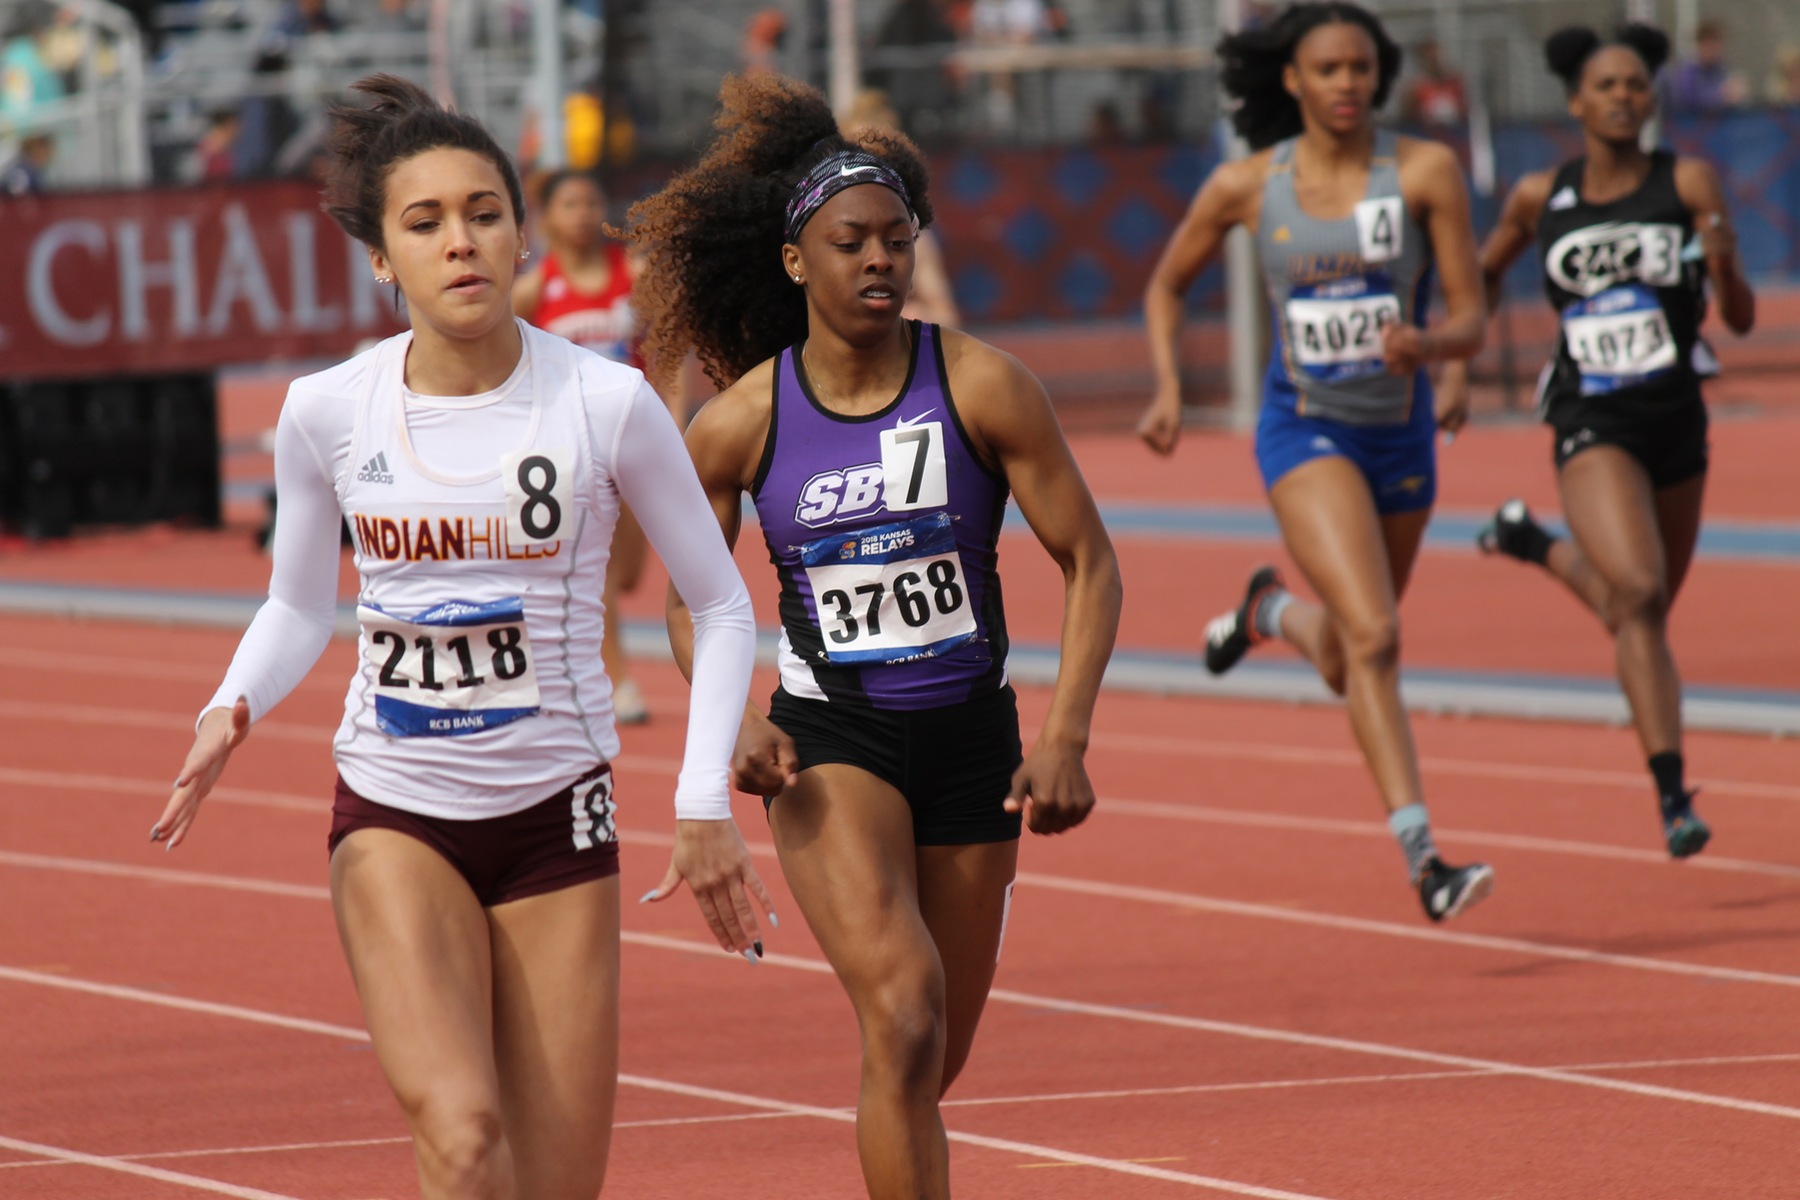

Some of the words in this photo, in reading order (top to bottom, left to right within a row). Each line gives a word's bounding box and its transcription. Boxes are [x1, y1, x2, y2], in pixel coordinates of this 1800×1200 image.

[1371, 208, 1393, 249] 4
[1653, 230, 1675, 280] 3
[1579, 318, 1664, 366] 1073
[357, 471, 394, 485] adidas
[895, 428, 930, 504] 7
[518, 455, 561, 540] 8
[795, 463, 886, 528] SB
[860, 535, 878, 544] 2018
[880, 528, 911, 541] KANSAS
[861, 535, 915, 556] RELAYS
[821, 559, 964, 644] 3768
[372, 626, 527, 691] 2118
[429, 718, 451, 730] RCB
[453, 714, 485, 729] BANK
